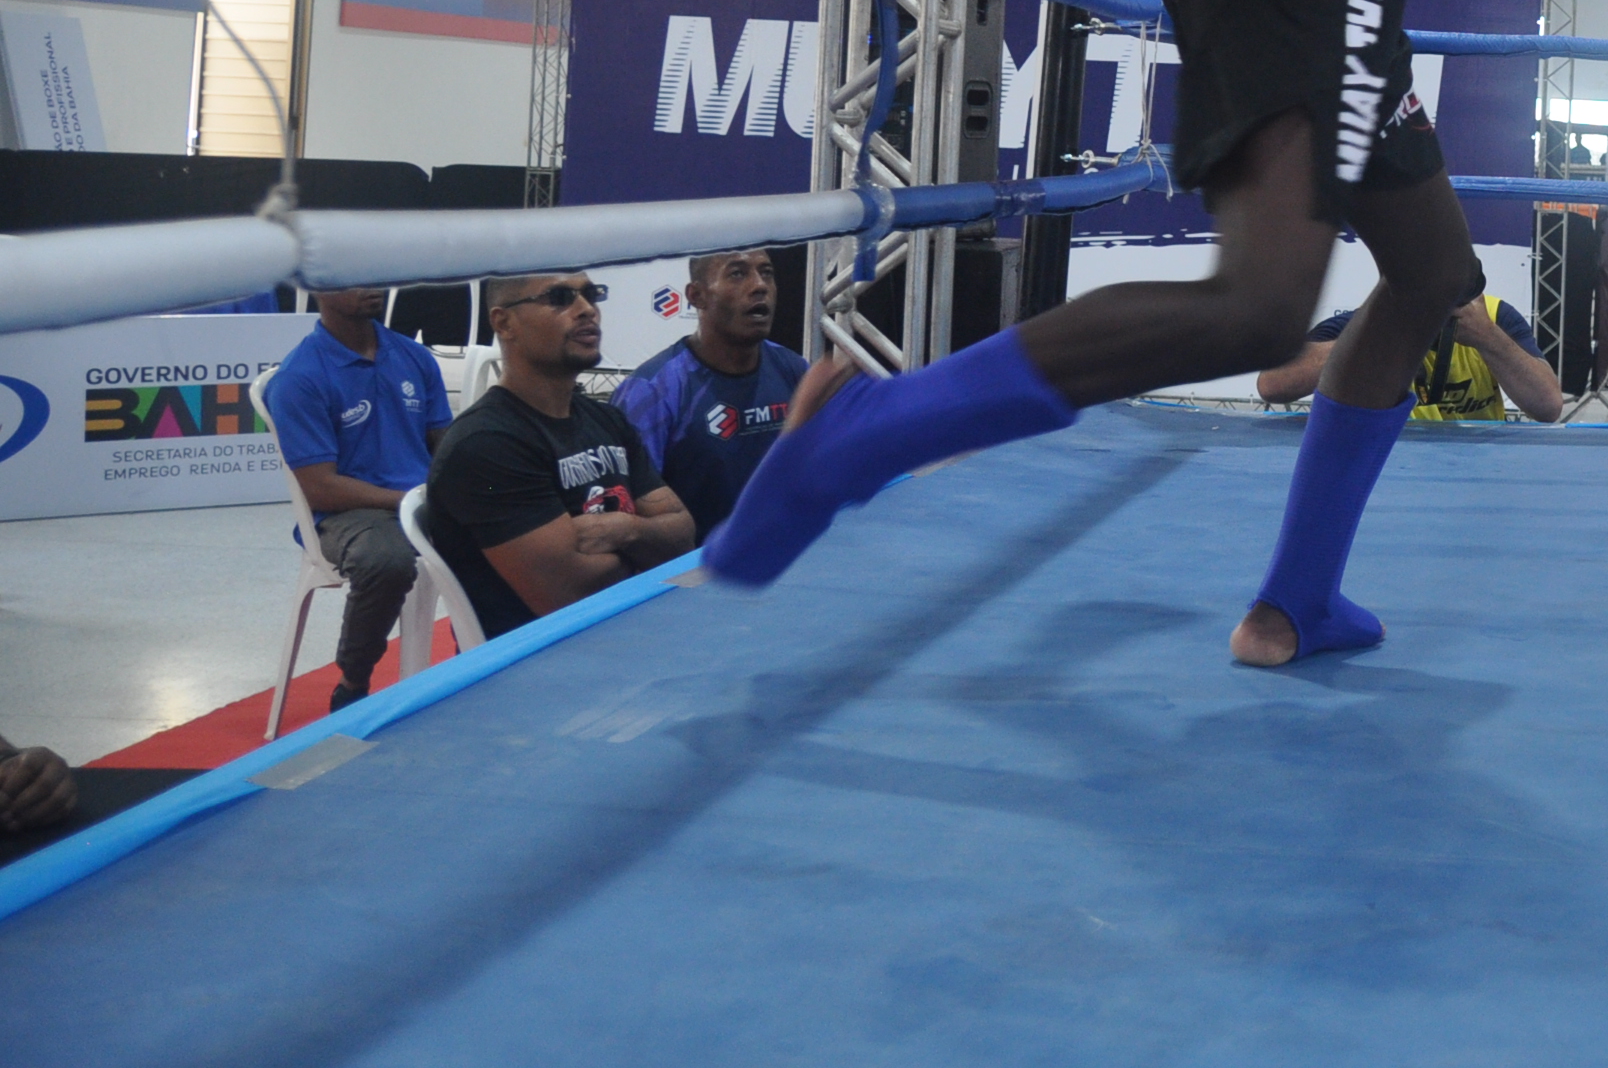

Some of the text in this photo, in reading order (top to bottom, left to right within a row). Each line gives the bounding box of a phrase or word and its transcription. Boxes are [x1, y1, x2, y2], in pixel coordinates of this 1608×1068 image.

[40, 69, 55, 108] BOXE
[44, 32, 71, 134] PROFISSIONAL
[61, 65, 77, 110] BAHIA
[49, 110, 59, 130] DE
[71, 112, 82, 132] DA
[1336, 54, 1387, 183] MUAY
[86, 364, 208, 385] GOVERNO
[216, 363, 249, 380] DO
[112, 443, 279, 463] SECRETARIA DO TRAB
[104, 465, 181, 481] EMPREGO
[190, 461, 242, 475] RENDA
[247, 461, 256, 472] E
